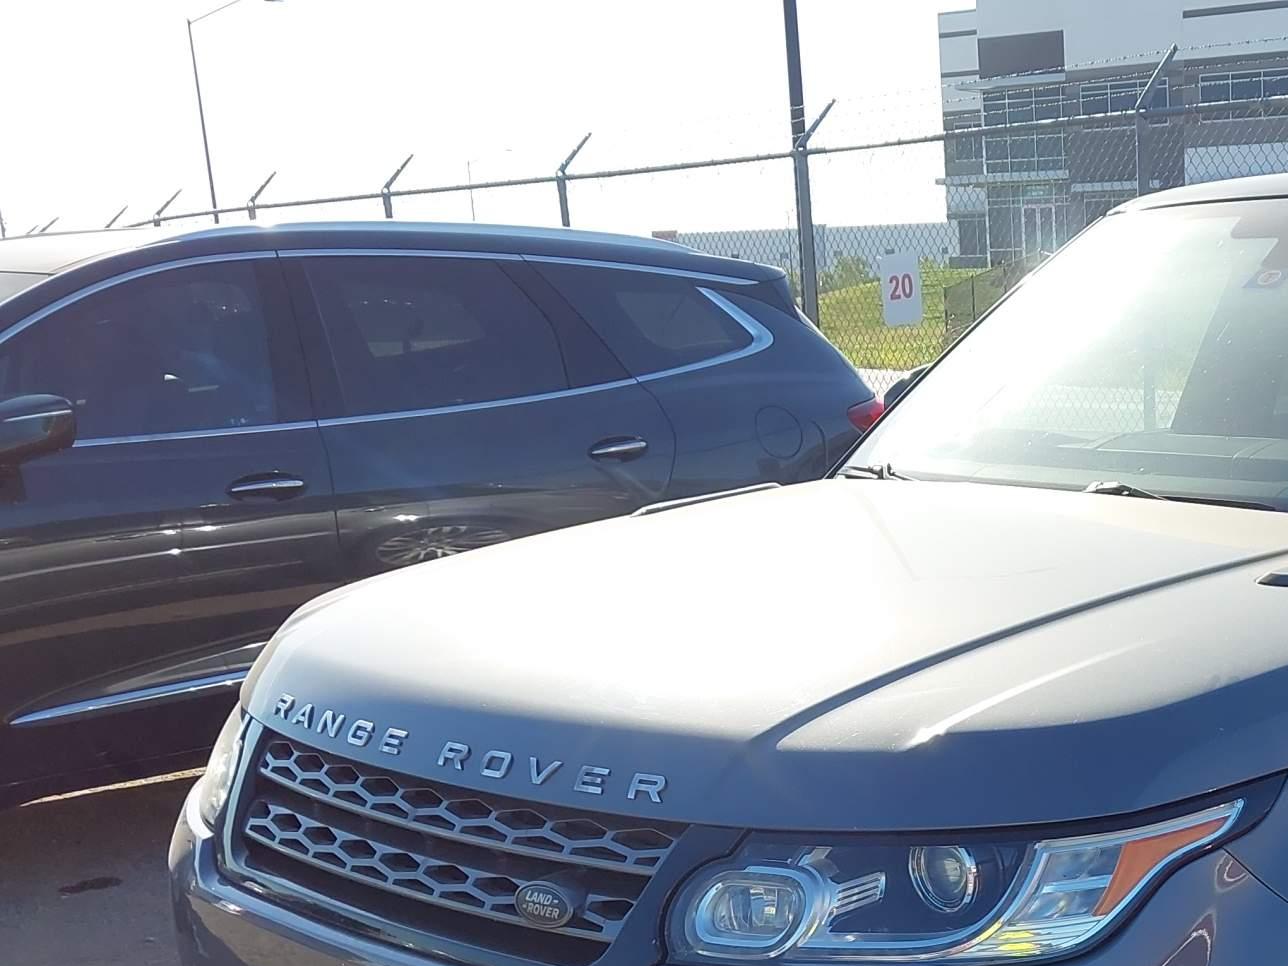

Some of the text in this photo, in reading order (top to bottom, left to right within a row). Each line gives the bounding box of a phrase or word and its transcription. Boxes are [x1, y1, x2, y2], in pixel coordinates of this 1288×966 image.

[888, 273, 914, 301] 20
[272, 692, 666, 803] RANGE ROVER
